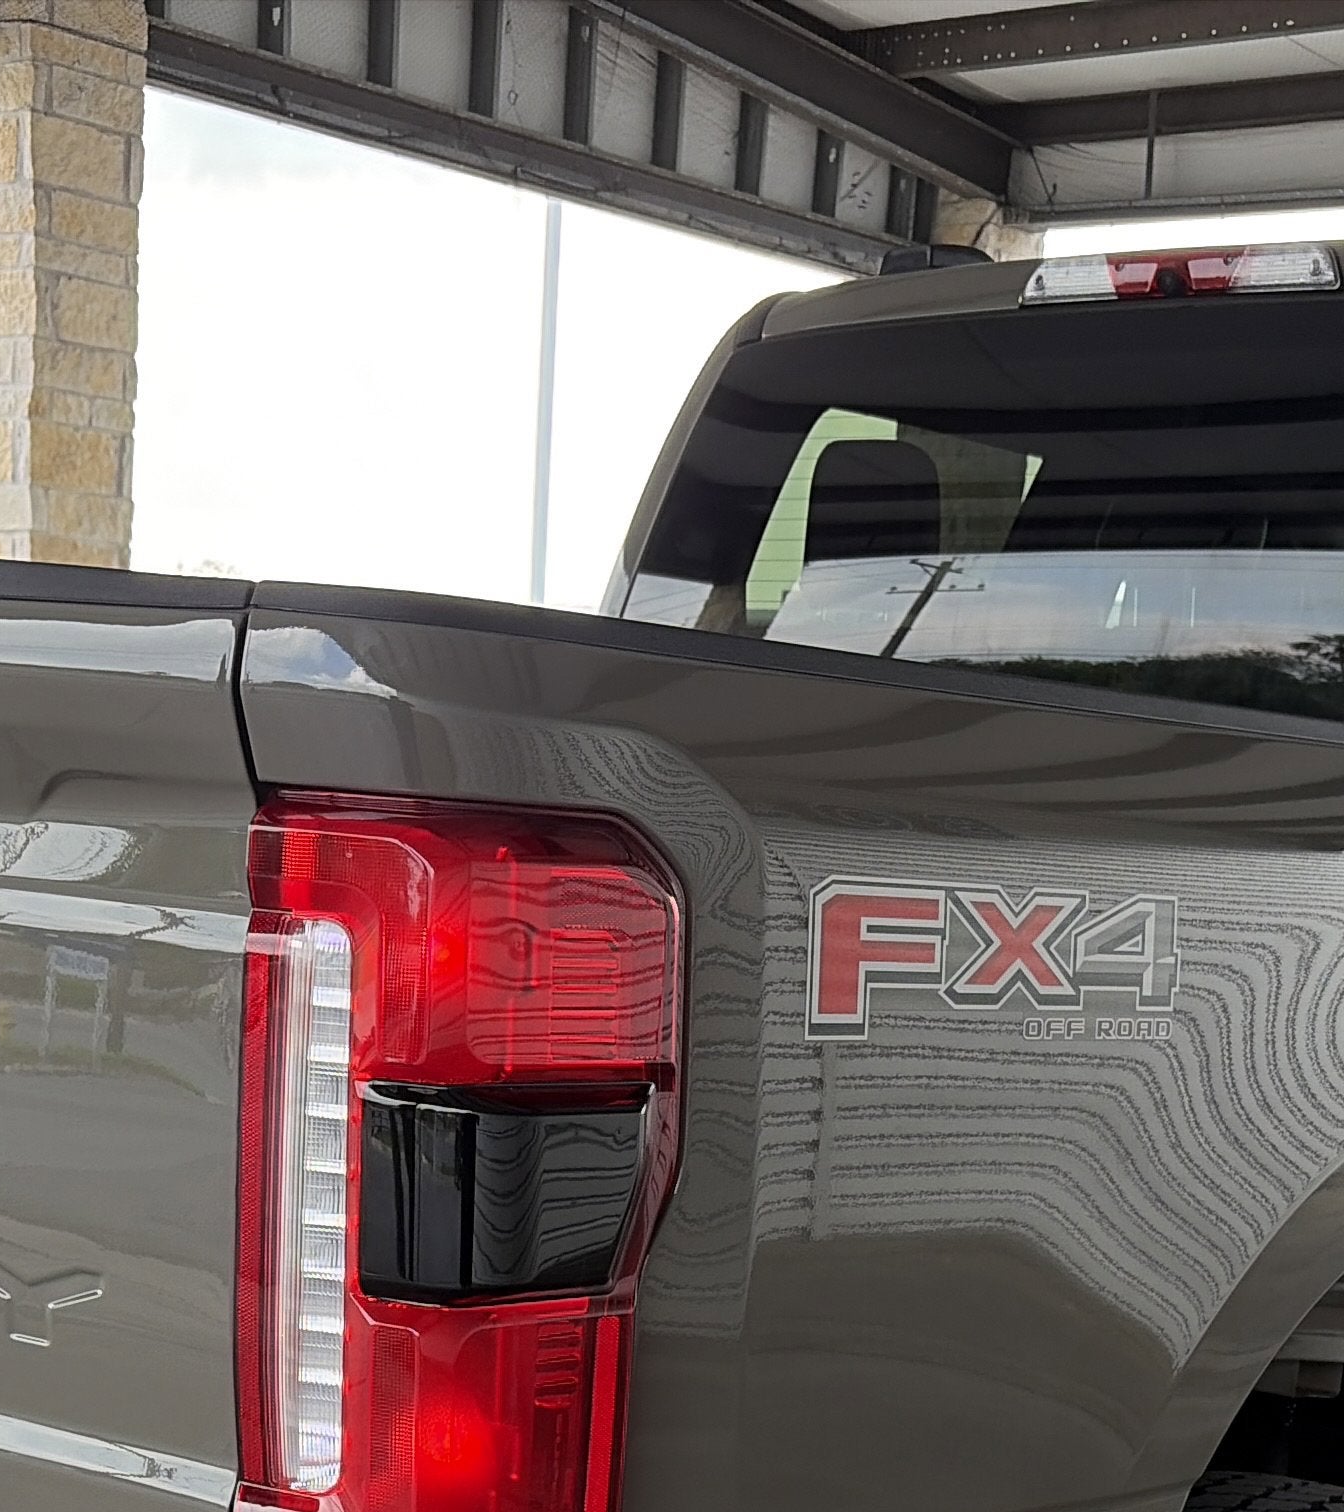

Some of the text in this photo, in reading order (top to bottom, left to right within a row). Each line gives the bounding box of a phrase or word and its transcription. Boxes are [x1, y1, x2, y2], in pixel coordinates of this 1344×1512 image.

[805, 875, 1180, 1040] FX4
[1023, 1018, 1172, 1041] OFF ROAD
